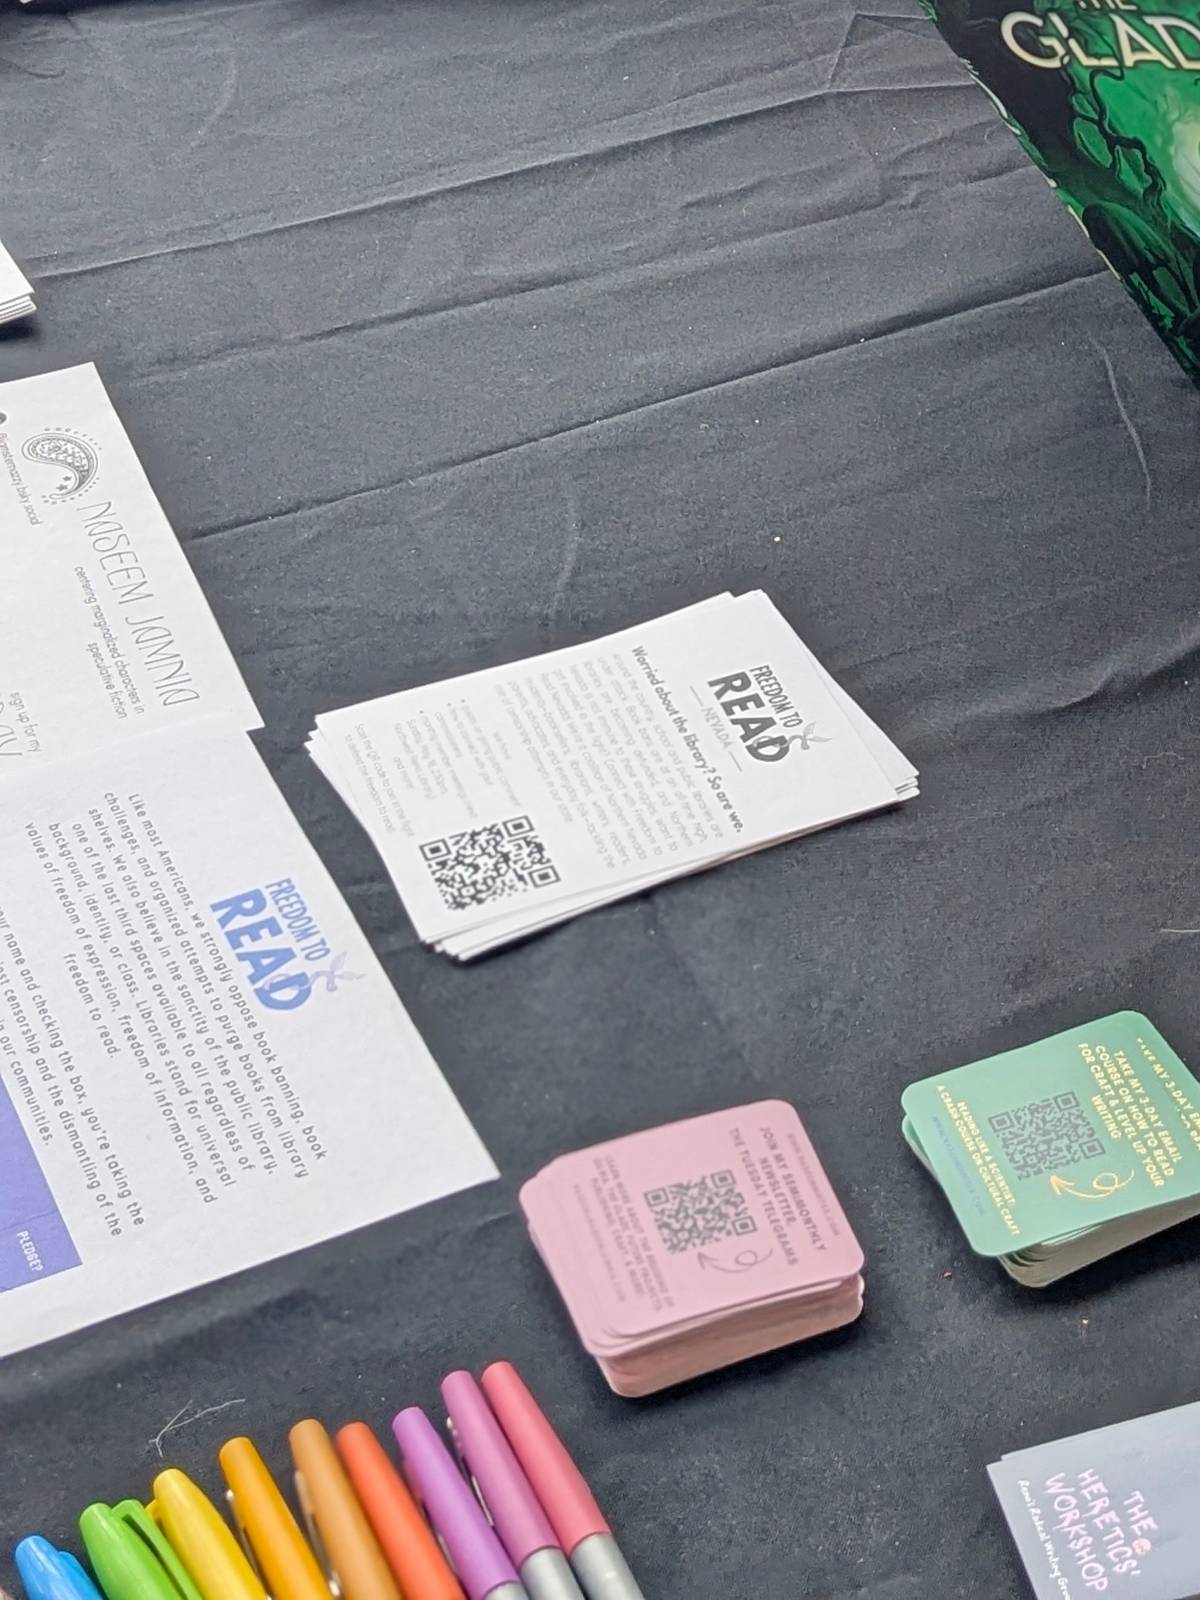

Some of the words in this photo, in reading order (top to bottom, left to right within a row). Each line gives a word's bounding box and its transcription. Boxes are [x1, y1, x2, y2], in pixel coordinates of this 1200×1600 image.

[74, 566, 97, 604] centering
[91, 604, 125, 659] marginalized
[114, 660, 141, 704] characters
[134, 706, 145, 714] in
[86, 642, 116, 690] speculative
[109, 690, 128, 719] fiction
[749, 665, 794, 714] FREEDOM
[779, 711, 803, 728] TO
[631, 646, 665, 686] Worried
[654, 686, 680, 717] about
[672, 716, 688, 734] the
[683, 733, 717, 774] library?
[707, 776, 722, 790] So
[716, 791, 733, 810] are
[728, 811, 743, 833] we.
[701, 707, 733, 749] NEVADA
[707, 671, 791, 762] READ
[72, 824, 89, 843] one
[104, 792, 140, 855] challenges,
[83, 846, 100, 858] of
[91, 861, 107, 880] the
[137, 857, 157, 877] and
[102, 882, 121, 905] last
[149, 880, 188, 937] organized
[114, 907, 139, 936] third
[265, 878, 320, 943] FREEDOM
[300, 937, 331, 962] TO
[130, 939, 157, 980] spaces
[180, 940, 215, 995] attempts
[209, 888, 313, 1011] READ
[88, 808, 116, 853] shelves.
[112, 854, 127, 872] We
[122, 875, 140, 898] also
[135, 900, 164, 943] believe
[158, 945, 171, 958] in
[166, 960, 182, 981] the
[177, 984, 209, 1034] sanctity
[204, 1037, 222, 1051] of
[213, 1054, 231, 1076] the
[222, 1080, 253, 1120] public
[247, 1122, 278, 1174] library,
[128, 793, 146, 817] Like
[142, 820, 163, 847] most
[157, 850, 194, 911] Americans,
[191, 913, 205, 928] we
[200, 932, 233, 982] strongly
[228, 985, 258, 1029] oppose
[253, 1031, 277, 1064] book
[270, 1066, 304, 1124] banning,
[302, 1125, 327, 1160] book
[152, 984, 187, 1040] available
[210, 997, 223, 1011] to
[182, 1043, 196, 1057] to
[215, 1015, 243, 1051] purge
[191, 1061, 209, 1078] all
[238, 1053, 265, 1092] books
[201, 1082, 243, 1152] regardless
[260, 1096, 283, 1129] from
[1078, 1043, 1096, 1064] FOR
[1090, 1064, 1115, 1096] CRAFT
[1109, 1099, 1119, 1107] &
[1114, 1108, 1137, 1139] LEVEL
[1132, 1140, 1147, 1154] UP
[1142, 1156, 1165, 1187] YOUR
[1091, 1095, 1122, 1139] WRITING
[1095, 1046, 1124, 1086] COURSE
[1118, 1087, 1134, 1104] ON
[1128, 1104, 1149, 1130] HOW
[1144, 1131, 1158, 1147] TO
[1153, 1149, 1174, 1176] READ
[1114, 1050, 1135, 1076] TAKE
[1128, 1078, 1145, 1094] MY
[1139, 1097, 1164, 1127] 3-DAY
[1158, 1130, 1182, 1163] EMAIL
[238, 1156, 256, 1170] of
[278, 1130, 309, 1178] library
[16, 1230, 44, 1271] PLEDGE?
[1043, 1472, 1108, 1591] WORKSHOP
[1077, 1468, 1141, 1576] HERETICS'
[1123, 1490, 1159, 1536] THE
